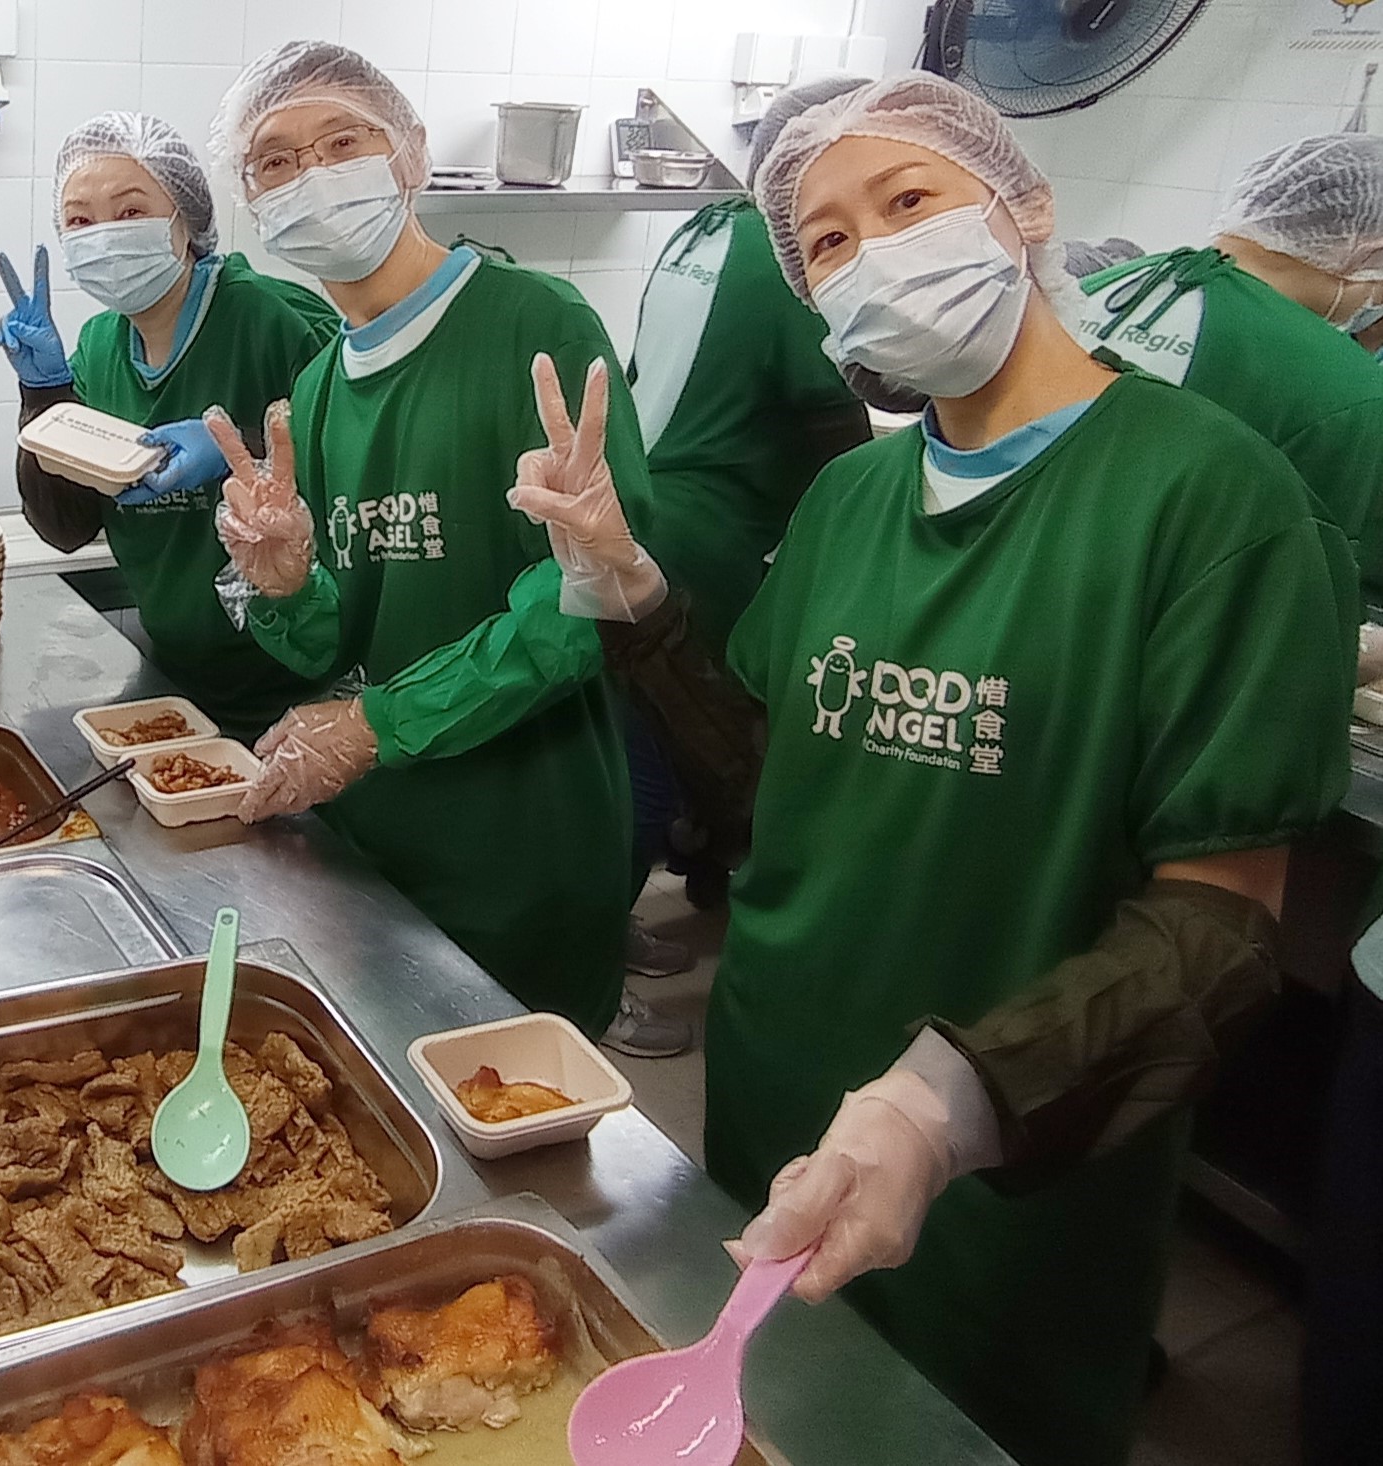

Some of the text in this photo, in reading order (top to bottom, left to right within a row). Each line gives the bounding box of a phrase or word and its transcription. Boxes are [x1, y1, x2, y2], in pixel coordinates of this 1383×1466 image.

[866, 704, 963, 752] NGEL
[969, 674, 1010, 775] 惜食堂
